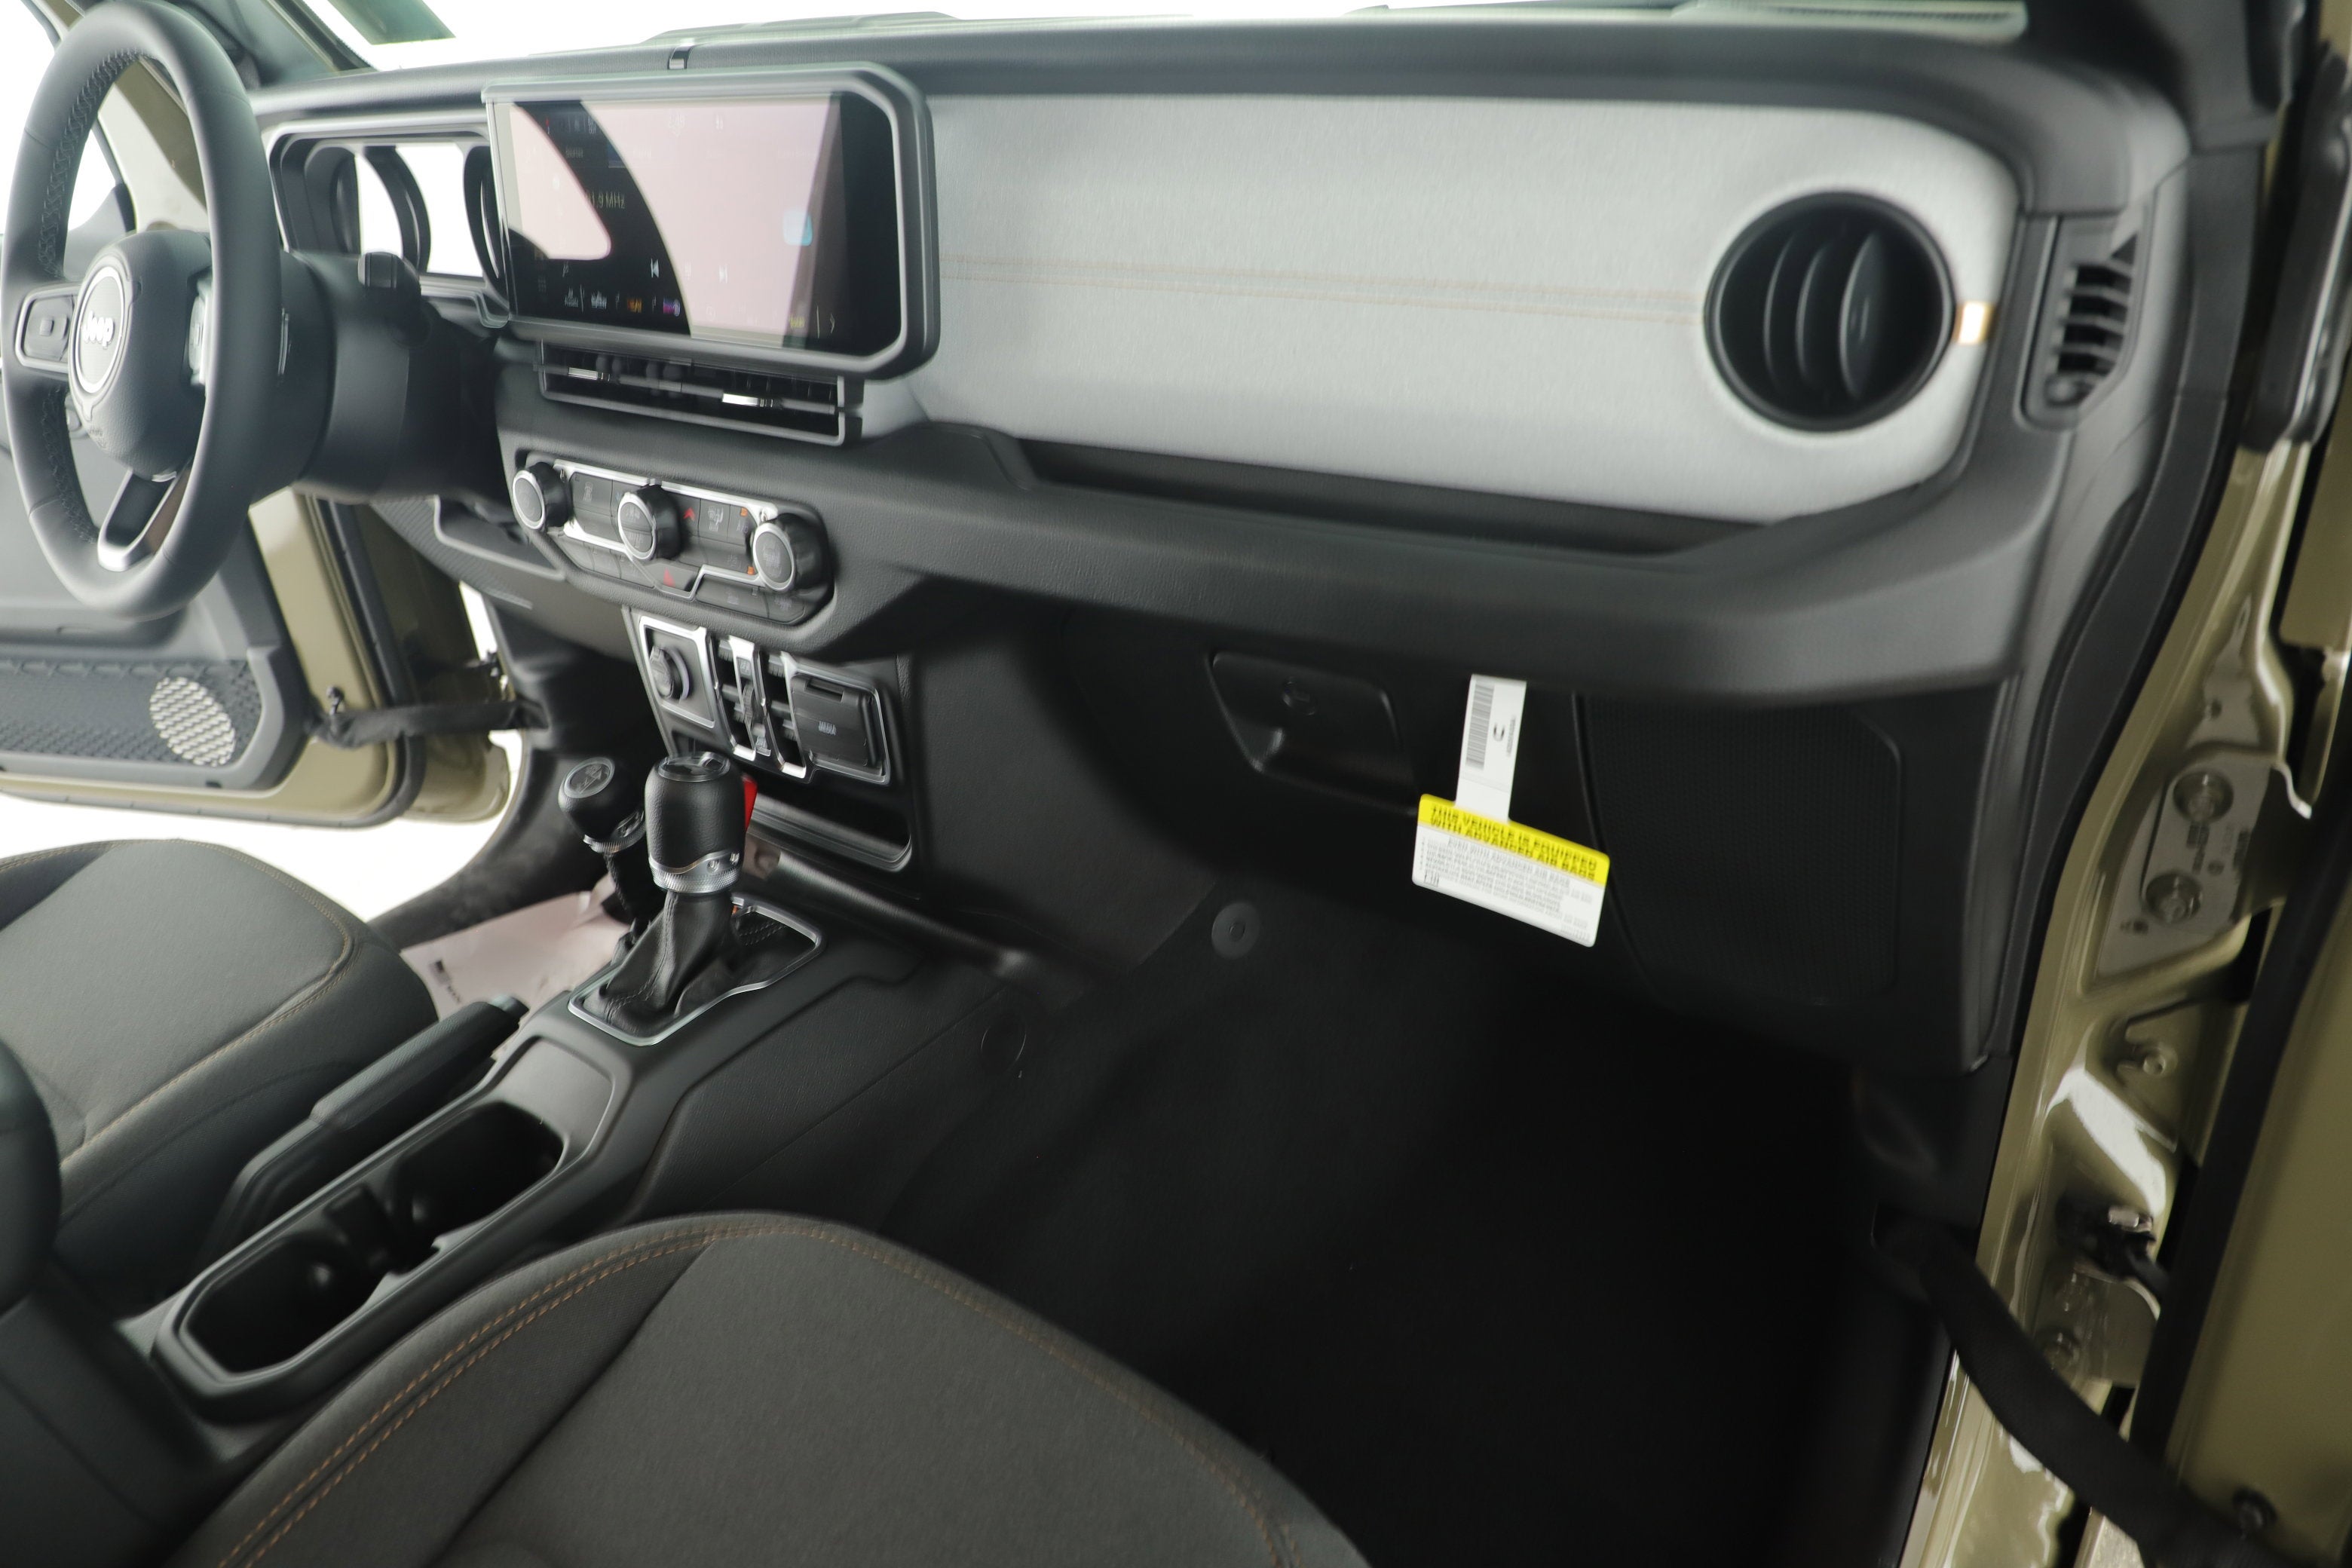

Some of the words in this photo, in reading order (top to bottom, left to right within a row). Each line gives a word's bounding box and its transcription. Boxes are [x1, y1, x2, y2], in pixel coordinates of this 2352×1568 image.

[83, 311, 115, 348] Jeep
[1430, 815, 1462, 834] WITH
[1465, 827, 1533, 859] ADVANCED
[1536, 852, 1557, 867] AIR
[1561, 861, 1595, 880] BAGS
[1432, 805, 1459, 824] THIS
[1462, 816, 1514, 843] VEHICLE
[1517, 835, 1530, 848] IS
[1533, 840, 1597, 871] EQUIPPED
